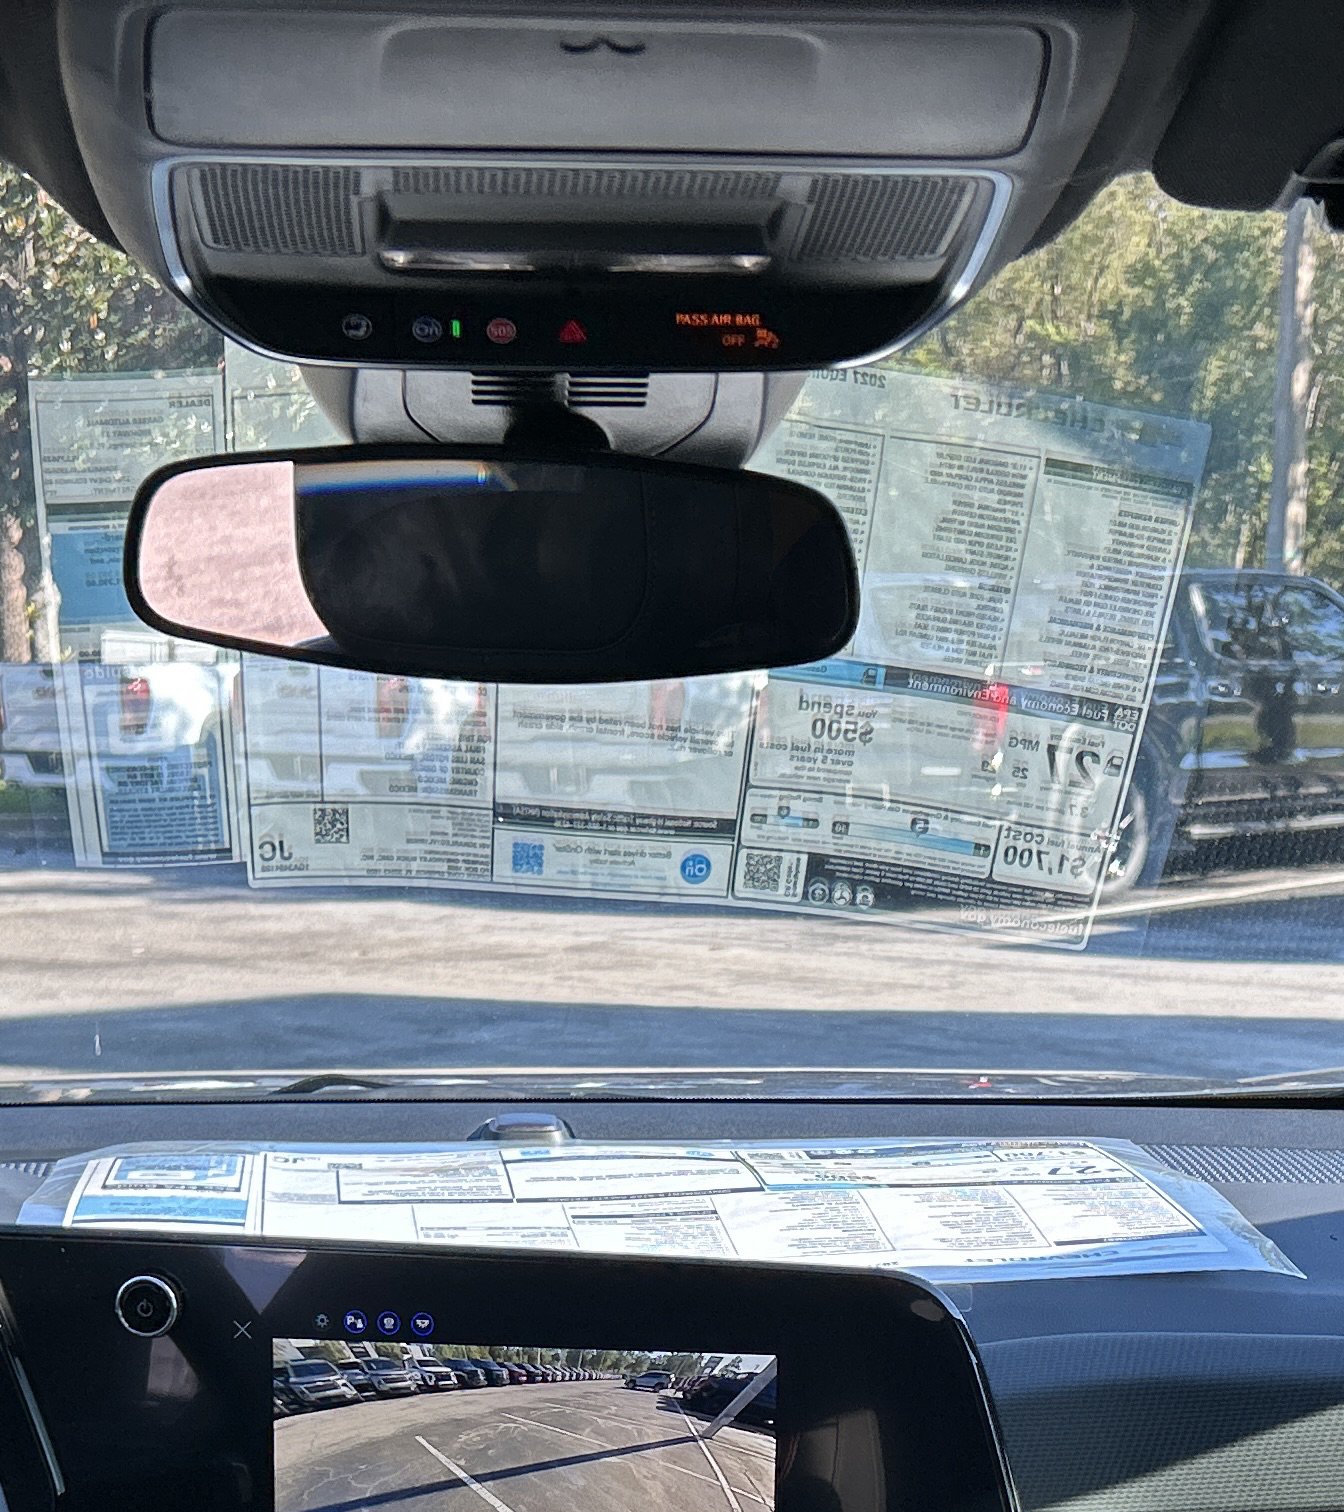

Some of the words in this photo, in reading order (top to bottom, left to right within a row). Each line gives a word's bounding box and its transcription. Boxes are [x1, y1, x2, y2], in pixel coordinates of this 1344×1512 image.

[675, 312, 706, 326] PASS
[711, 313, 732, 326] AIR
[735, 313, 760, 326] BAG
[490, 324, 515, 337] SOS
[721, 334, 746, 347] OFF
